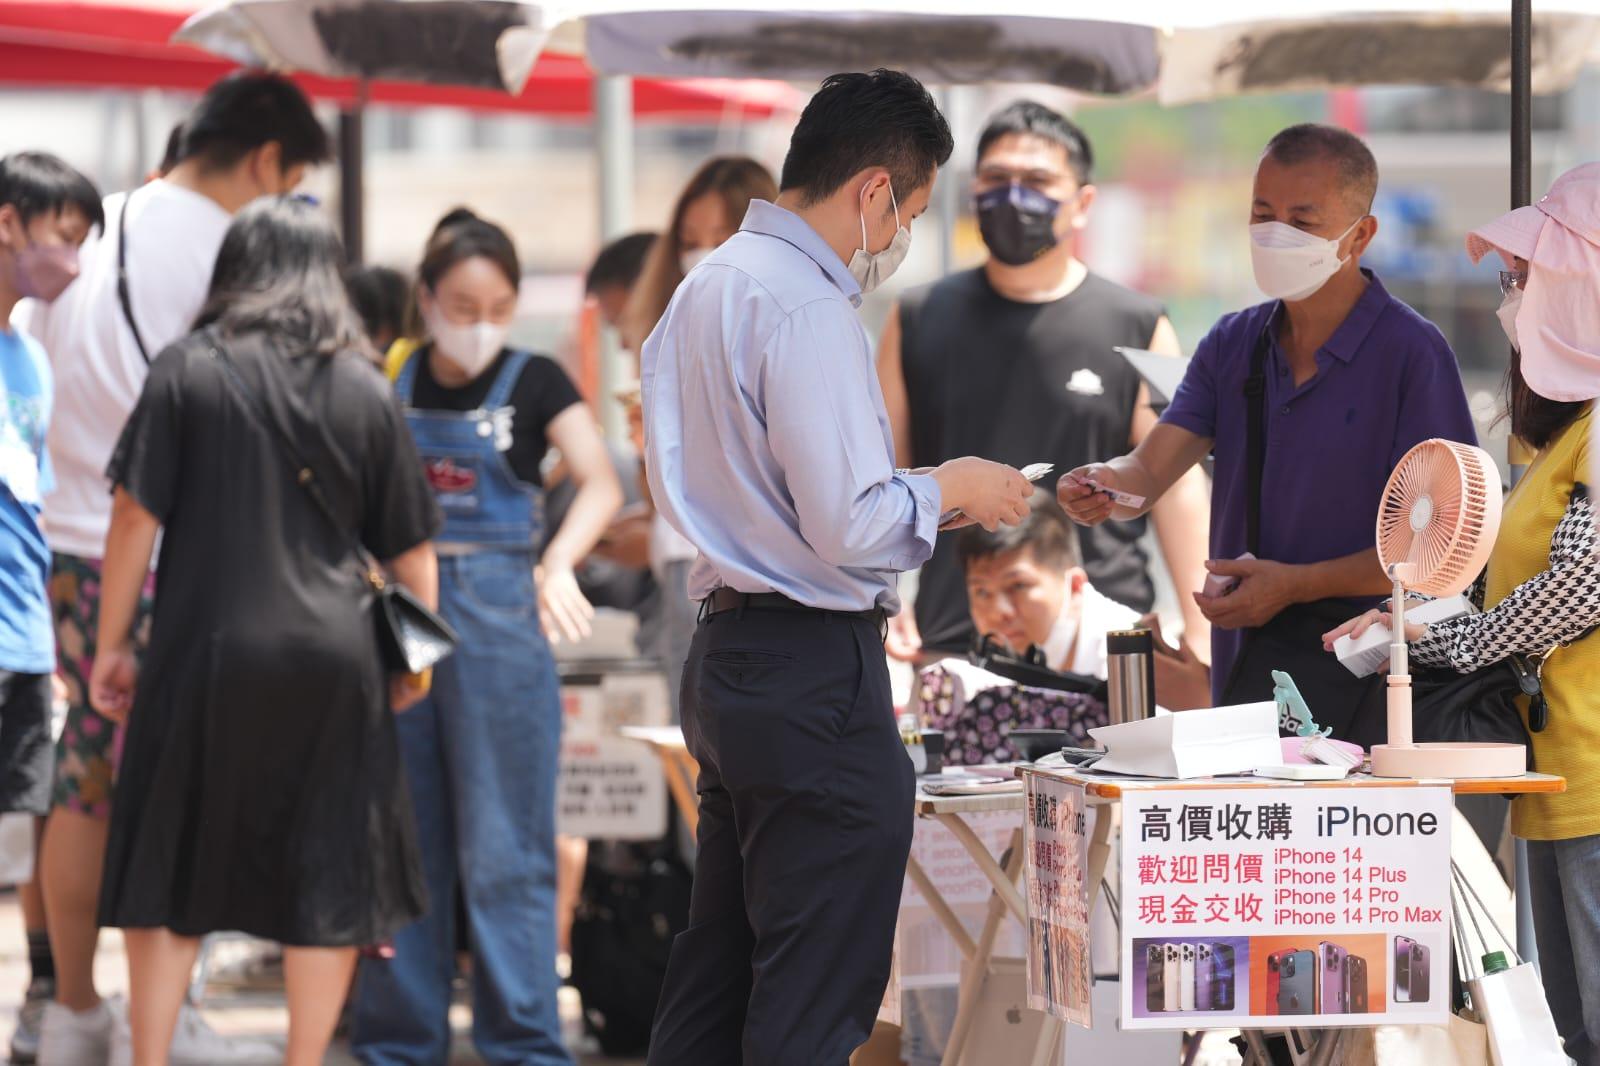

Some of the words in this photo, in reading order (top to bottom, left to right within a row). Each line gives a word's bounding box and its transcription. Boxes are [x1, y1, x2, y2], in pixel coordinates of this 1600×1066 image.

[1139, 802, 1293, 842] 高價收購
[1317, 806, 1438, 837] iPhone
[1274, 848, 1336, 864] iPhone
[1342, 848, 1362, 863] 14
[1137, 852, 1264, 886] 歡迎問價
[1274, 868, 1336, 884] iPhone
[1342, 867, 1362, 883] 14
[1368, 866, 1407, 883] Plus
[1138, 891, 1264, 925] 現金交收
[1274, 887, 1336, 905] iPhone
[1342, 887, 1362, 903] 14
[1368, 886, 1400, 904] Pro
[1274, 909, 1336, 926] iPhone
[1342, 907, 1362, 923] 14
[1368, 907, 1399, 923] Pro
[1405, 906, 1441, 923] Max
